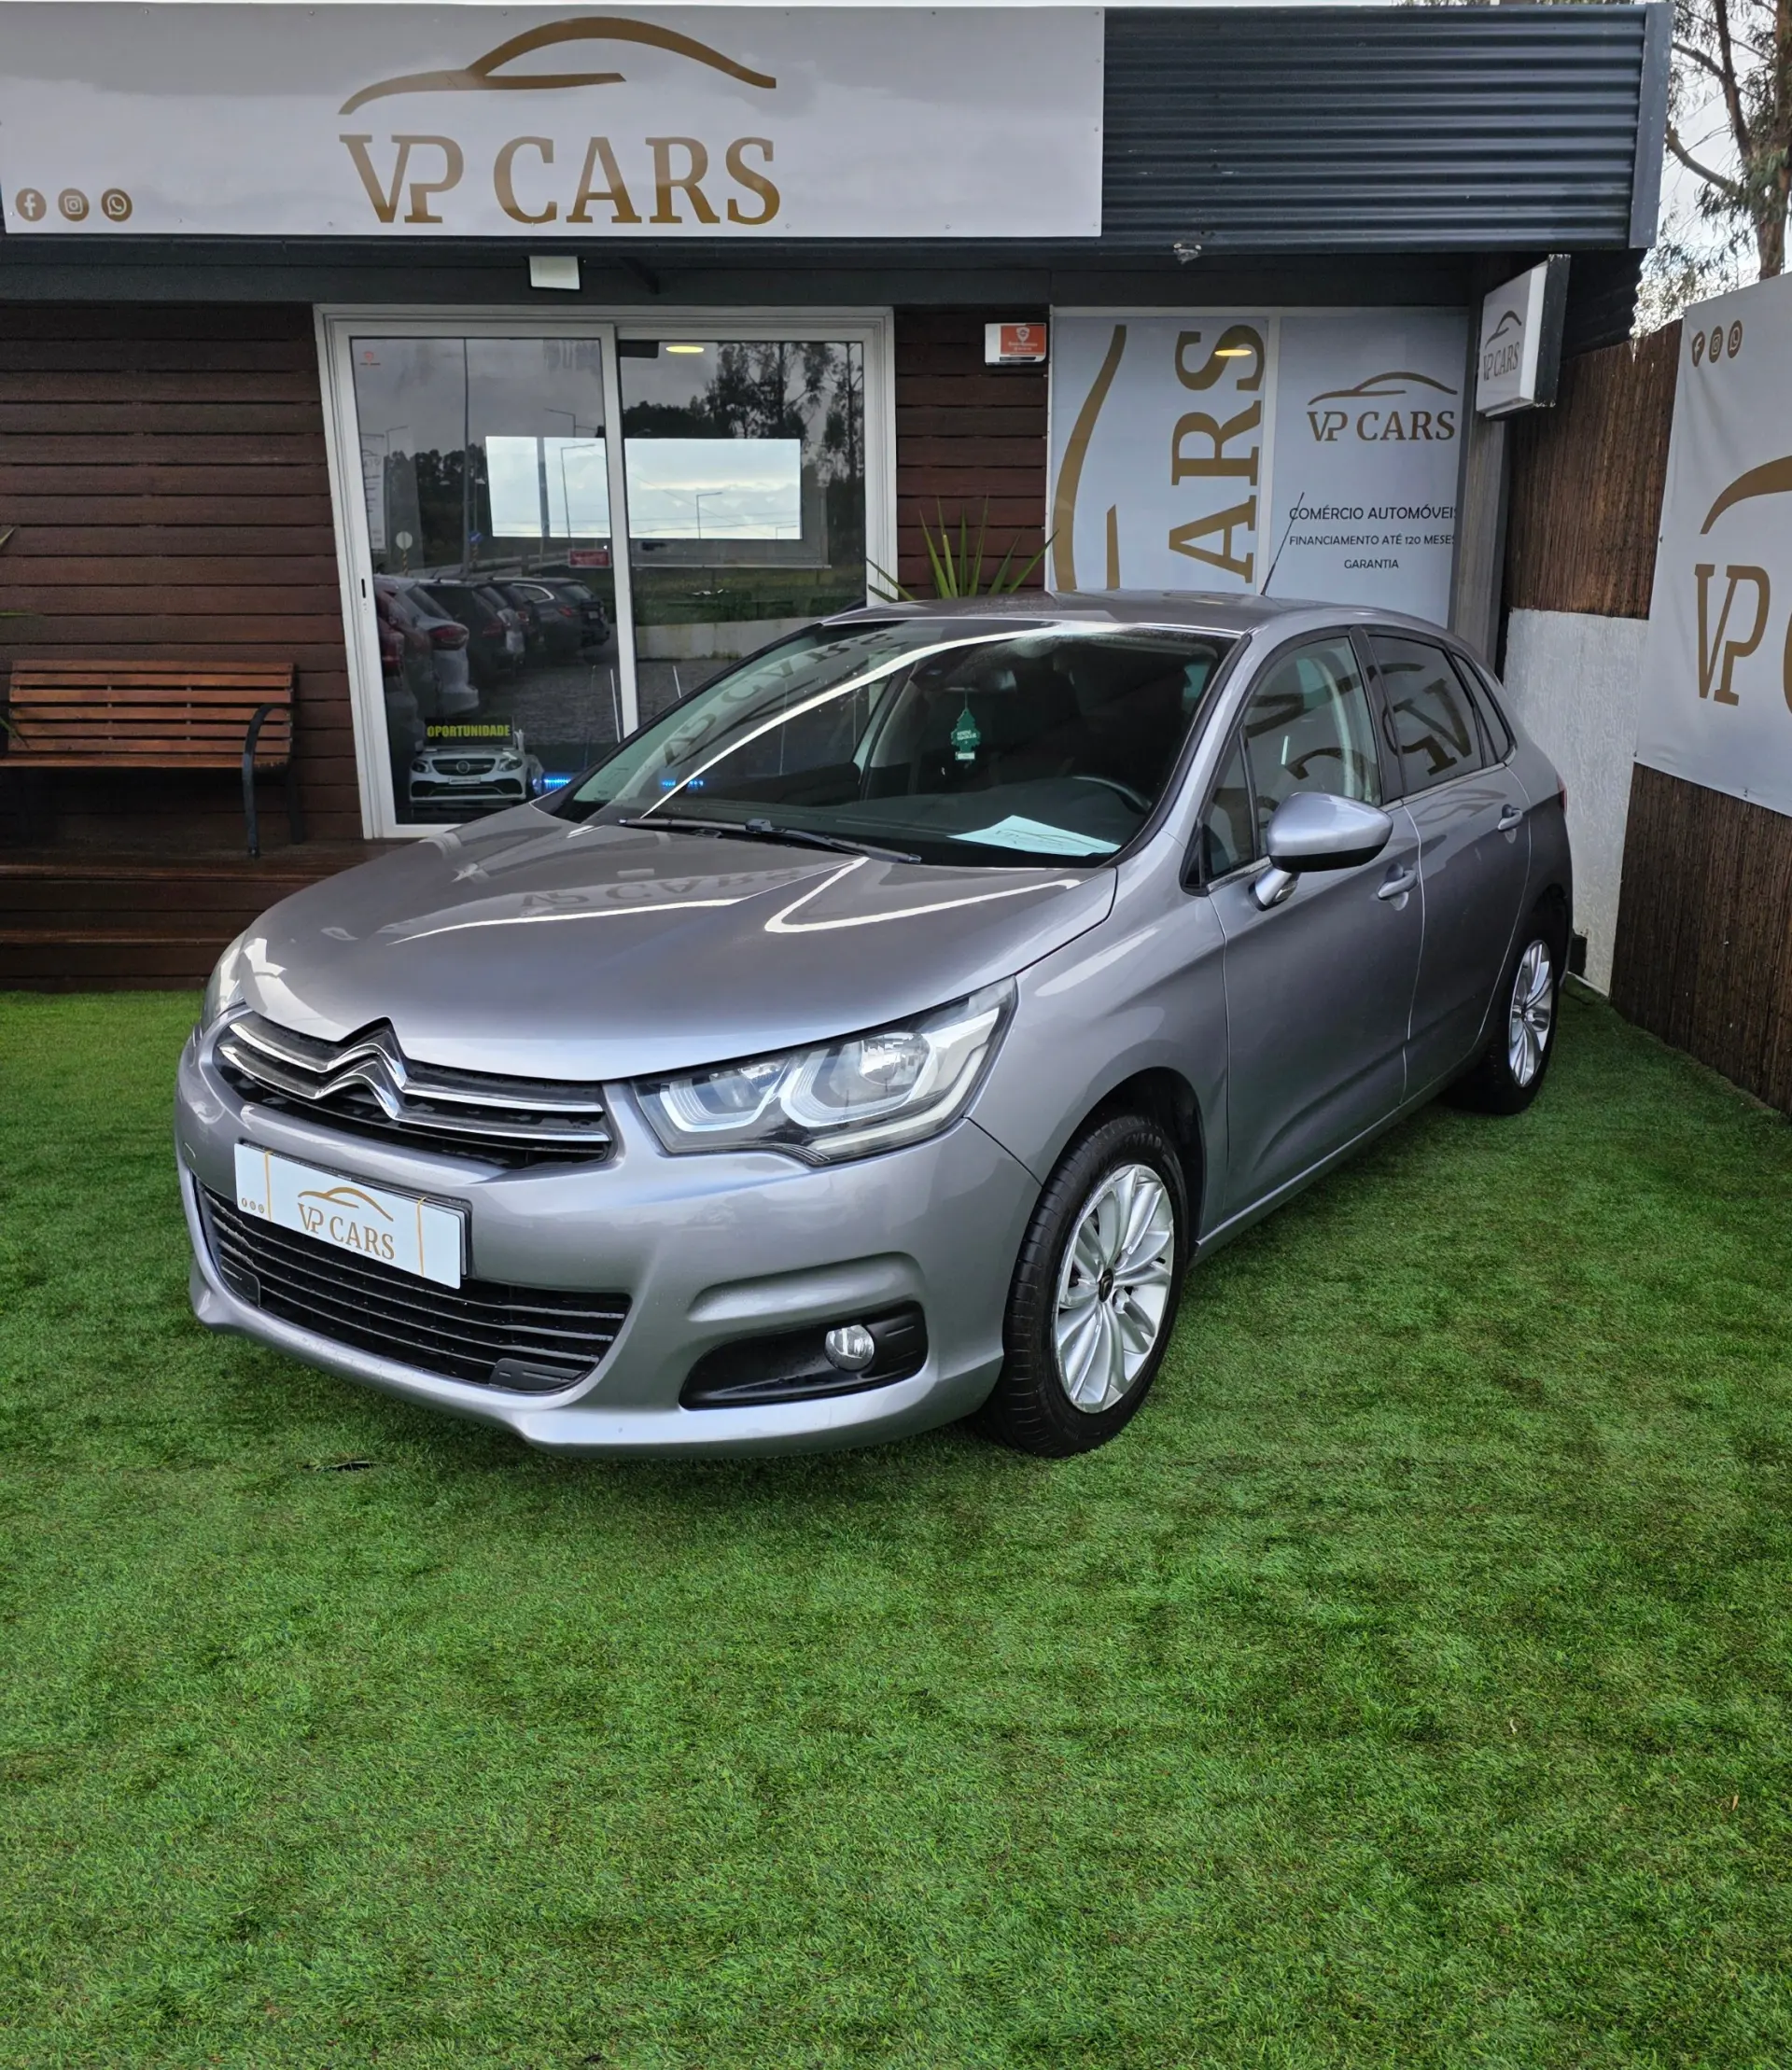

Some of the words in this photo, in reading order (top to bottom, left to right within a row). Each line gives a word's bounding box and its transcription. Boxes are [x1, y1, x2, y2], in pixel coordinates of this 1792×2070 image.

[339, 134, 464, 224] VP
[493, 135, 781, 225] CARS
[1494, 341, 1520, 377] CARS
[1307, 411, 1349, 441] VP
[1356, 411, 1456, 441] CARS
[1289, 505, 1365, 520] COMÉRCIO
[1289, 535, 1379, 546] FINANCIAMENTO
[1381, 533, 1401, 545] ATÉ
[1405, 536, 1421, 545] 120
[1344, 559, 1399, 569] GARANTIA
[1694, 563, 1771, 707] VP
[427, 724, 511, 737] OPORTUNIDADE
[298, 1202, 325, 1235] VP
[329, 1215, 395, 1260] CARS
